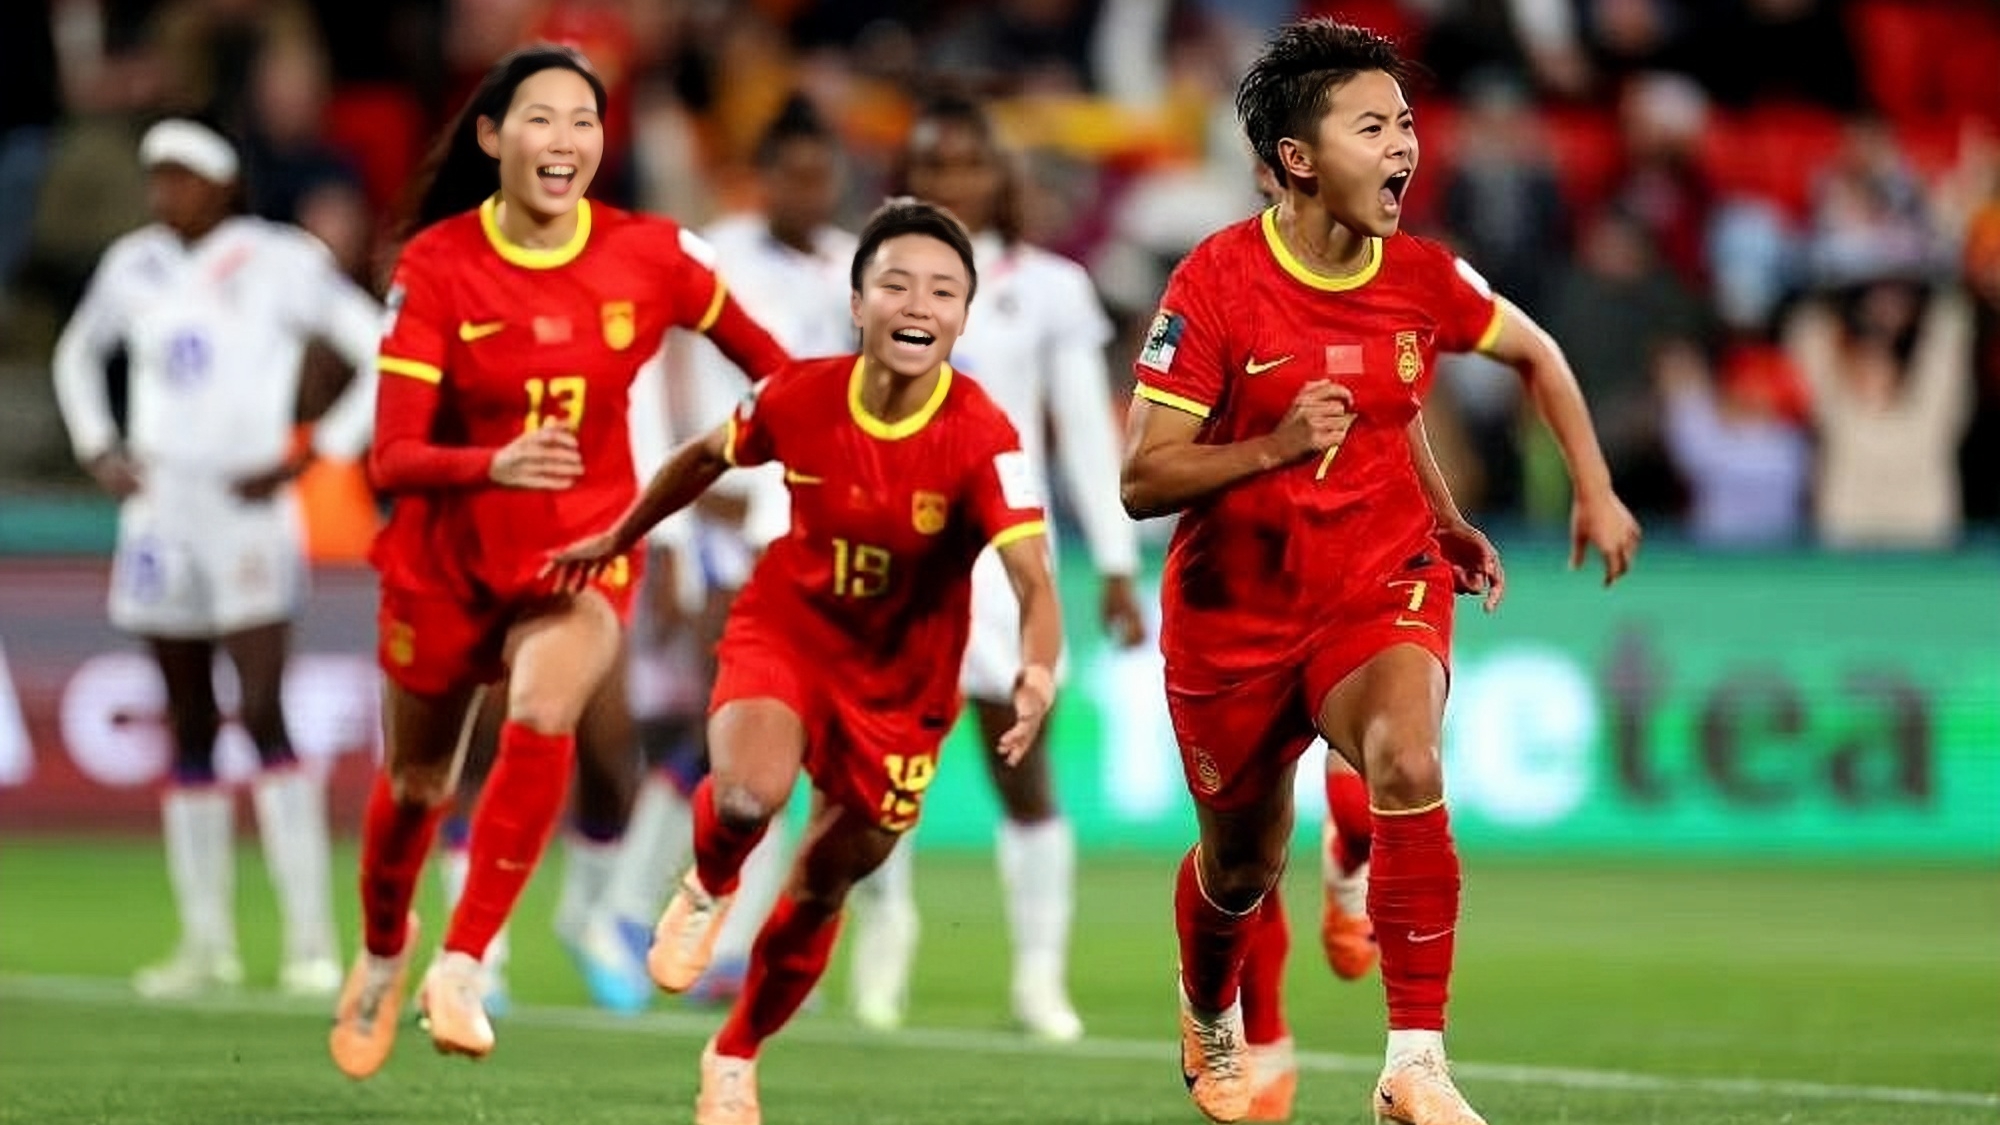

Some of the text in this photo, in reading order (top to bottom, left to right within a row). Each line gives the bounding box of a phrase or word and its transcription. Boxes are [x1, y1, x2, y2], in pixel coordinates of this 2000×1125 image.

[524, 376, 587, 435] 13
[831, 537, 891, 598] 19
[1387, 580, 1427, 612] 7
